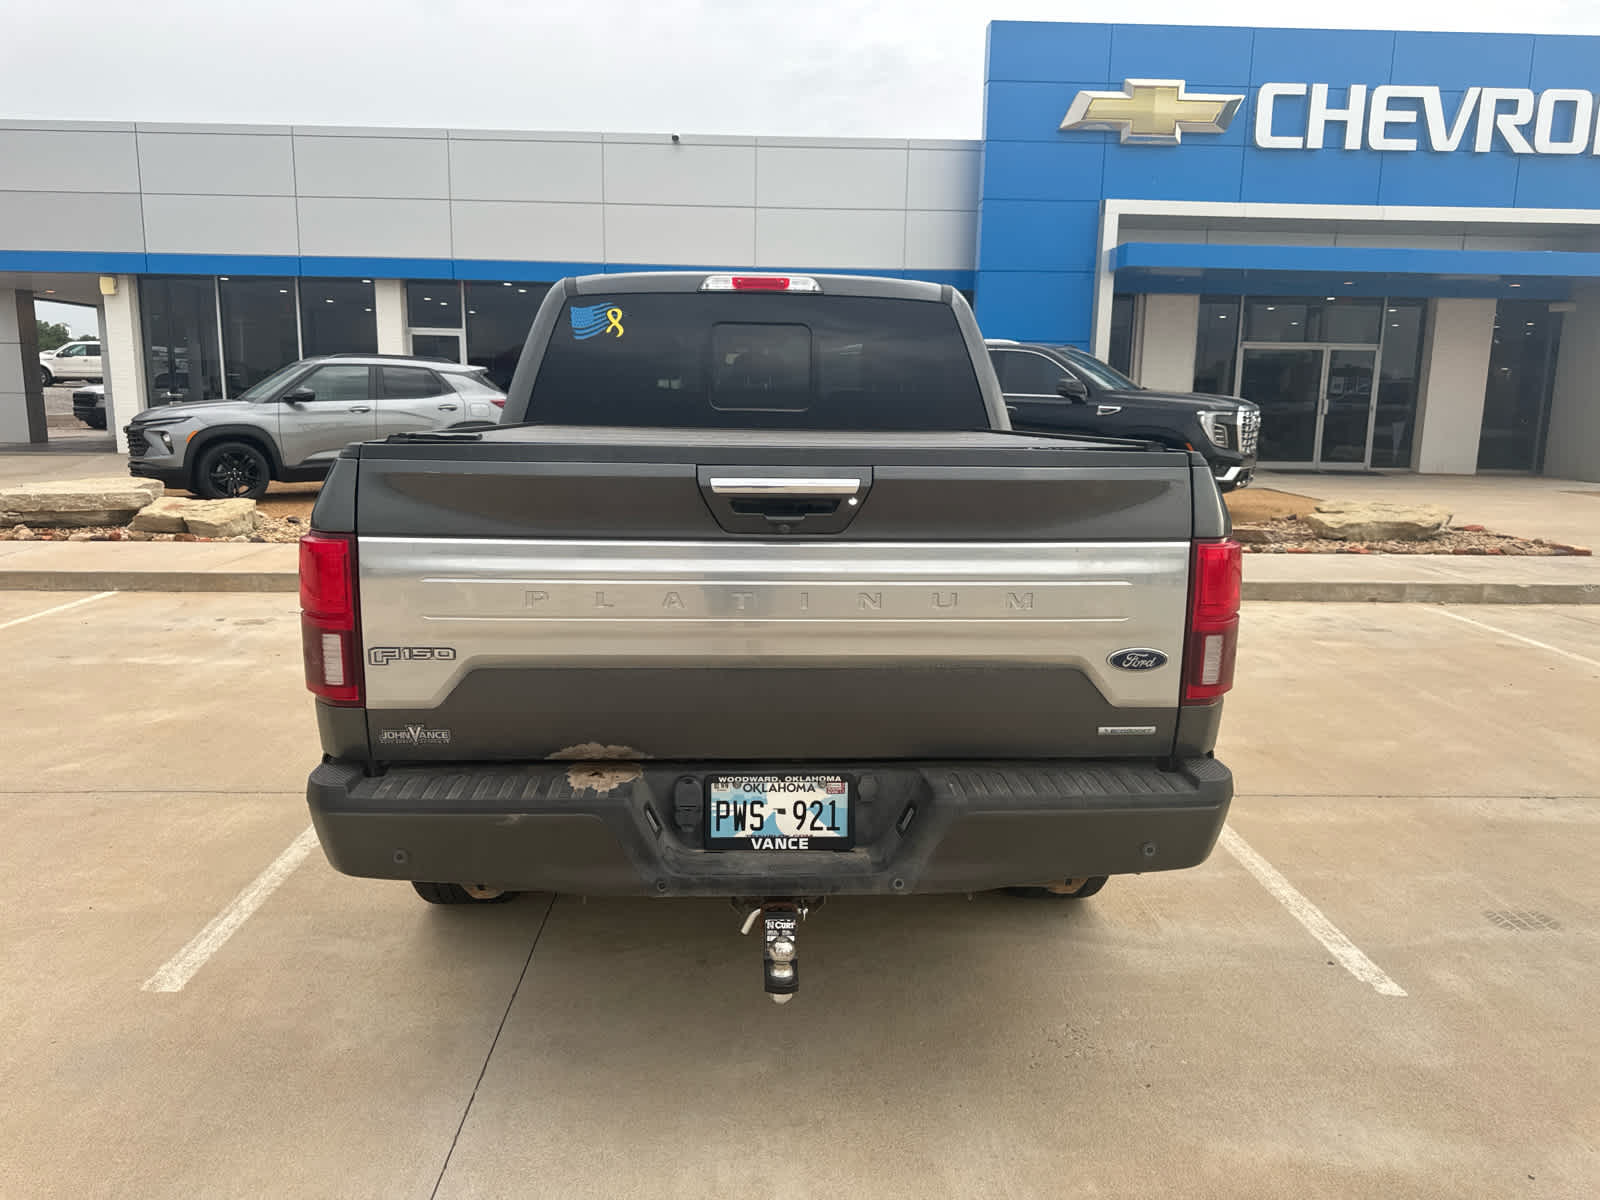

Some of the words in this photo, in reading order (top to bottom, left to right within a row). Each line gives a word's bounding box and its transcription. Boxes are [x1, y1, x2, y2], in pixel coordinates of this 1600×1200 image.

[1255, 82, 1600, 155] CHEVRO
[523, 589, 1035, 611] PLATINUM
[1122, 652, 1157, 668] Ford
[784, 775, 842, 783] OKLAHOMA
[742, 783, 816, 794] OKLAHOMA
[751, 837, 809, 850] VANCE
